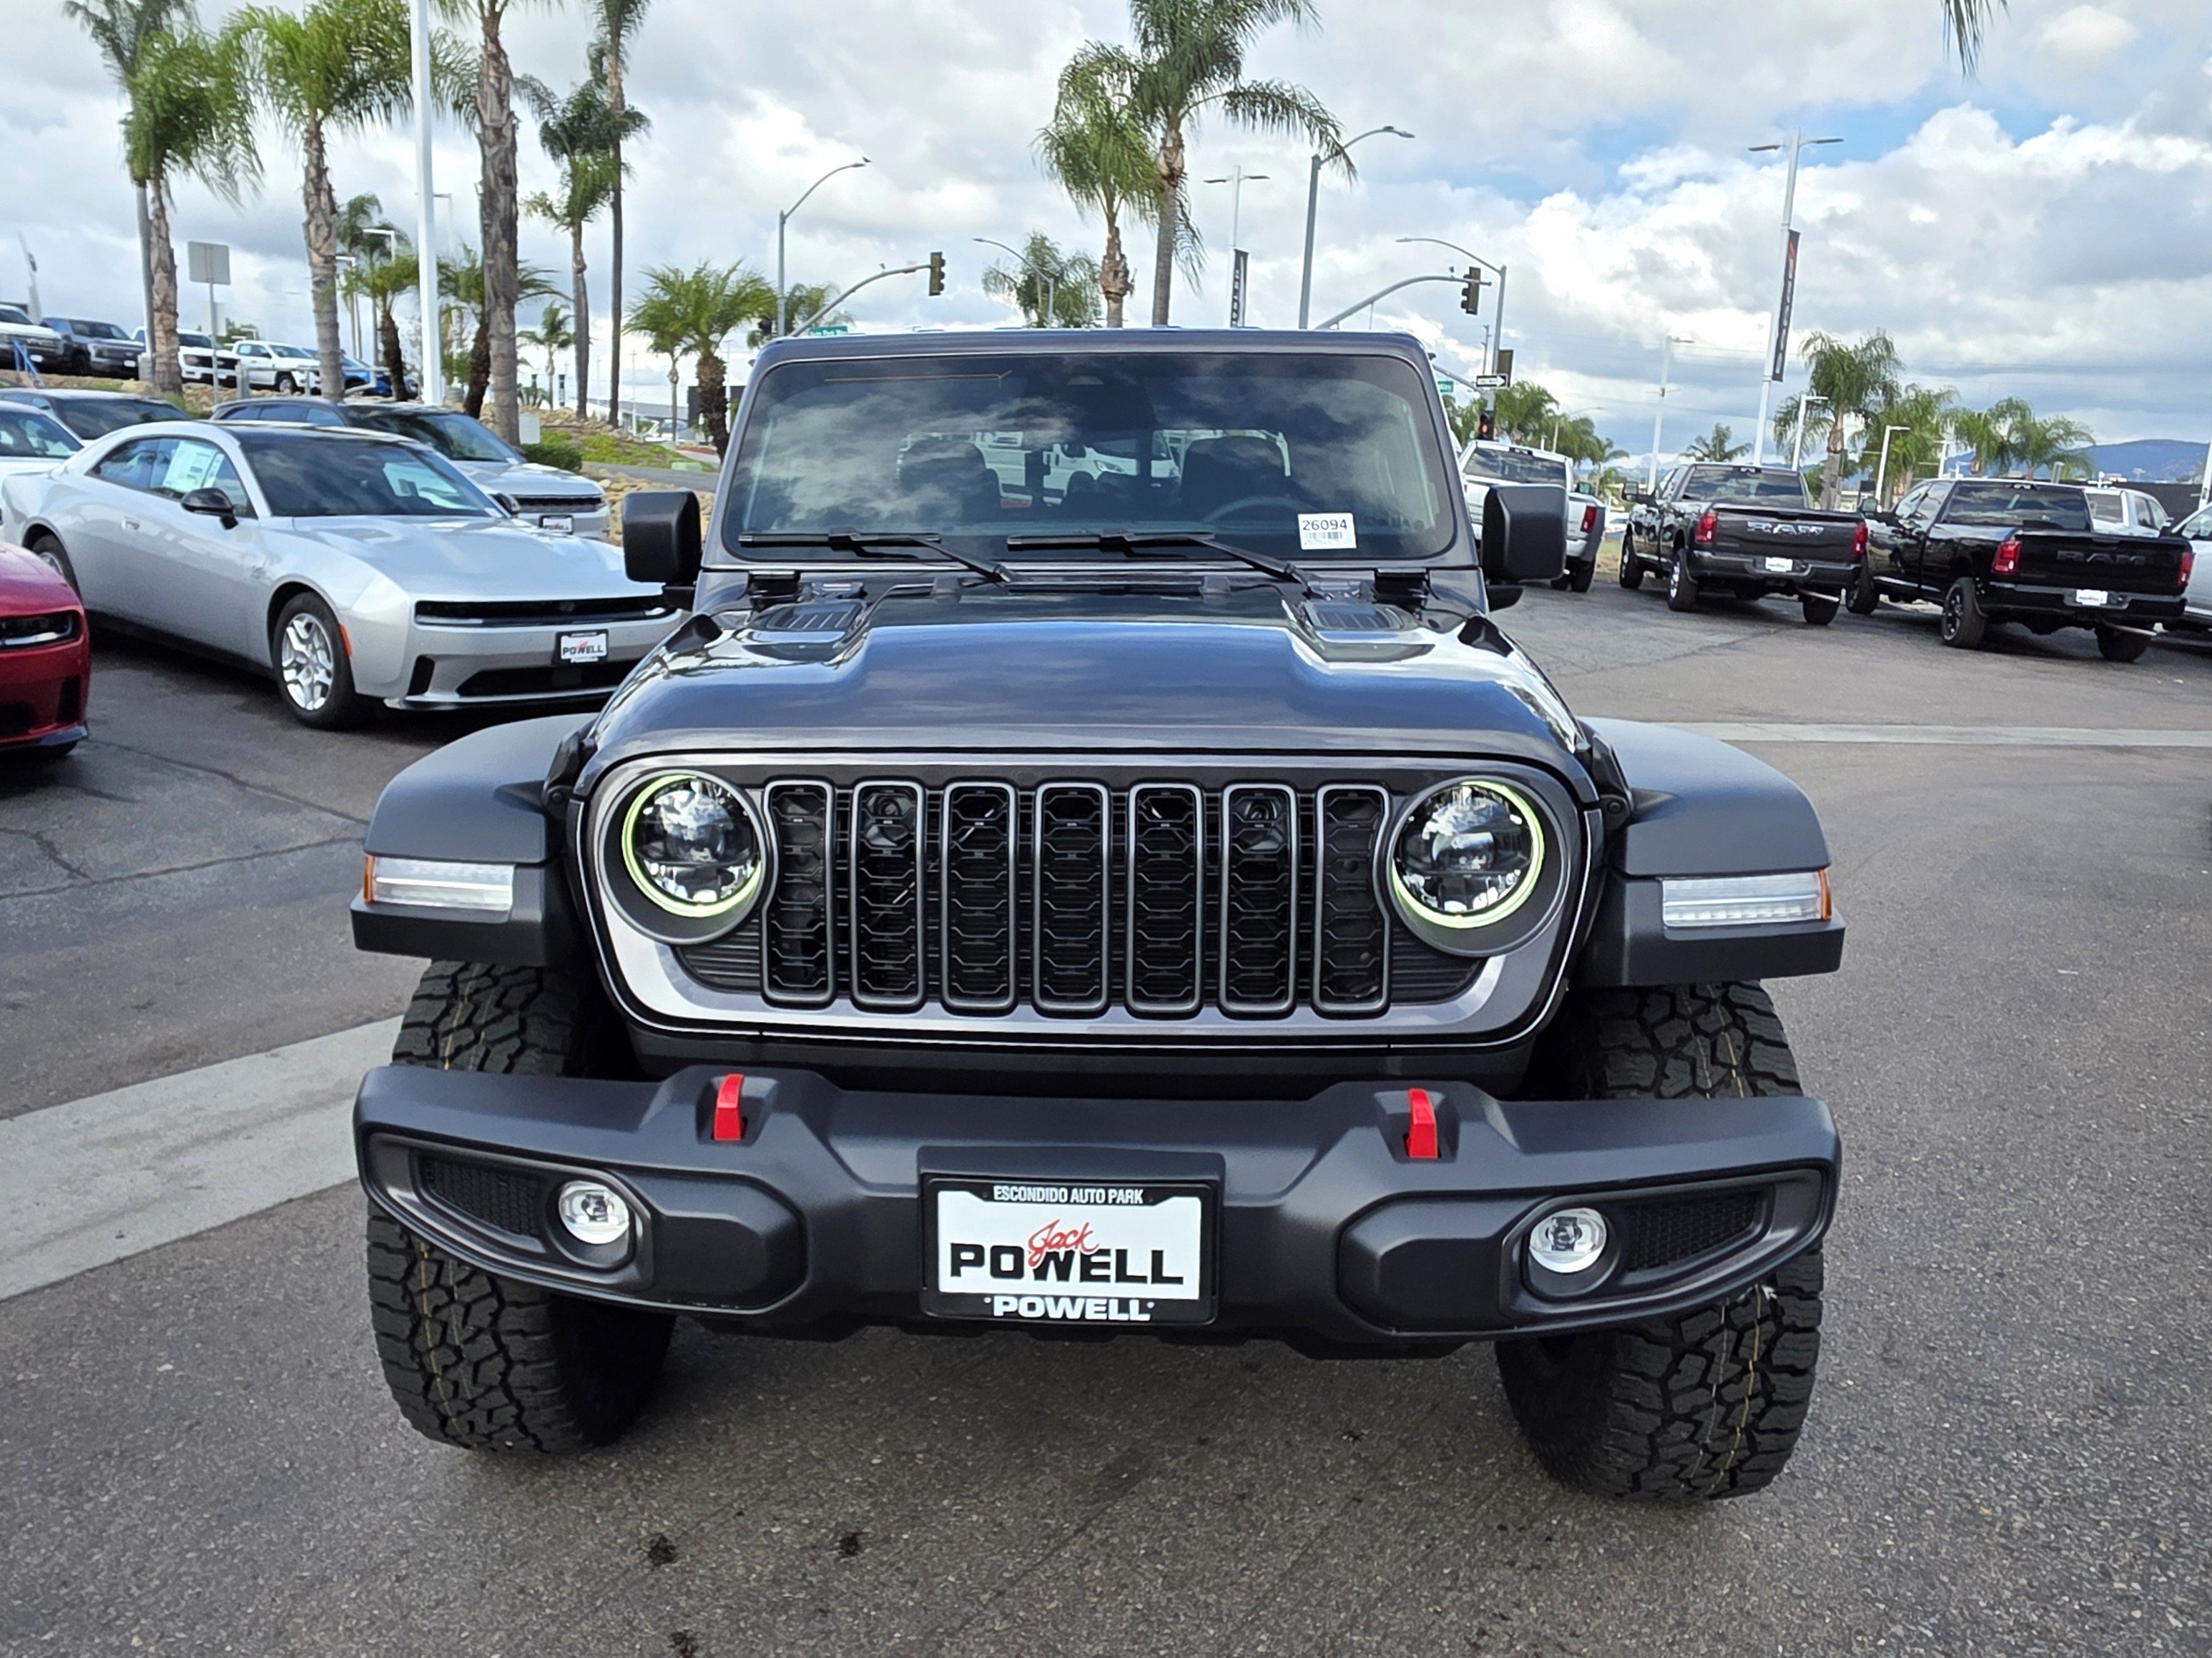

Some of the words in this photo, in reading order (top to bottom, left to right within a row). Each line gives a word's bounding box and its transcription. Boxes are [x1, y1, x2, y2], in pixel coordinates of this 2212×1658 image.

[1302, 519, 1347, 531] 26094
[1747, 521, 1824, 536] RAM
[2057, 551, 2145, 566] RAM
[562, 645, 604, 655] POWELL
[993, 1185, 1068, 1203] ESCONDIDO
[1069, 1188, 1106, 1203] AUTO
[1108, 1189, 1143, 1205] PARK
[1028, 1219, 1099, 1268] Jack
[950, 1243, 1184, 1285] POWELL
[993, 1296, 1151, 1321] POWELL
